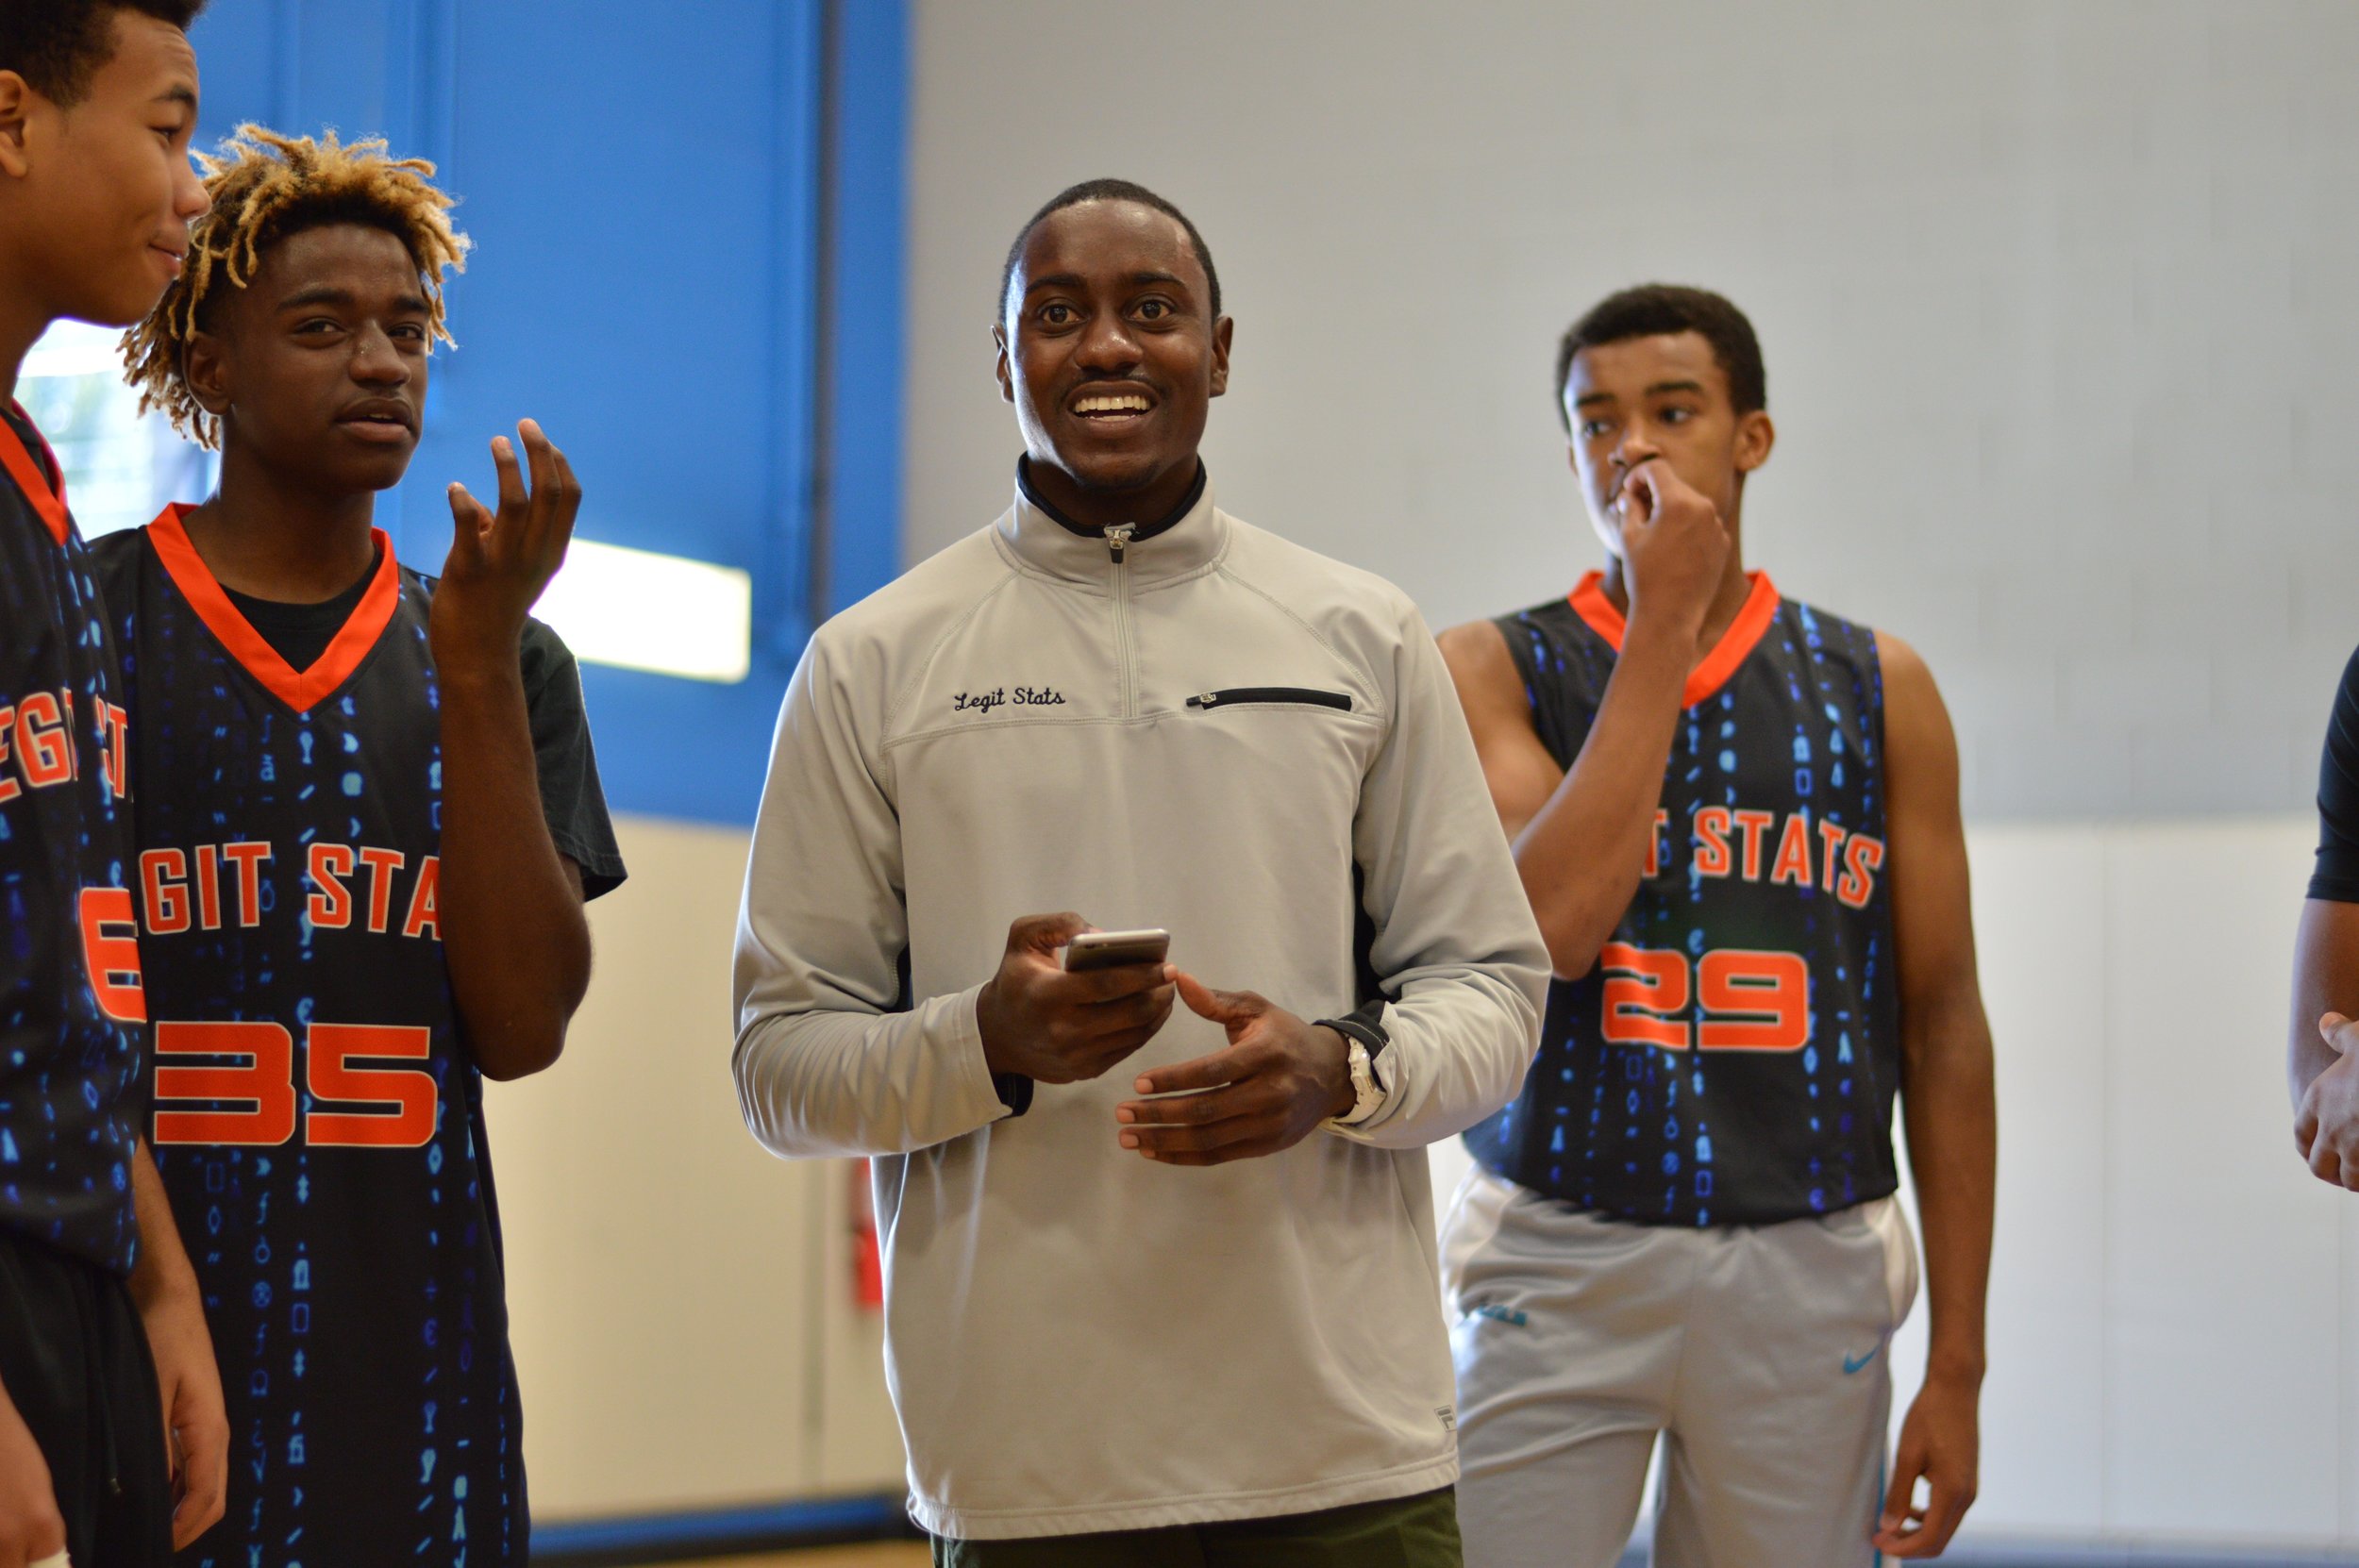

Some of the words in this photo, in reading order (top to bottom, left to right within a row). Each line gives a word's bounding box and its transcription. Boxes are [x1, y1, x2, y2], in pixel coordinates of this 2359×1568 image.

[953, 687, 1006, 714] Legit
[1012, 687, 1066, 705] Stats
[139, 841, 272, 936] GIT
[307, 842, 443, 942] STA
[1693, 805, 1884, 909] STATS
[1599, 940, 1809, 1053] 29
[153, 1020, 439, 1148] 35
